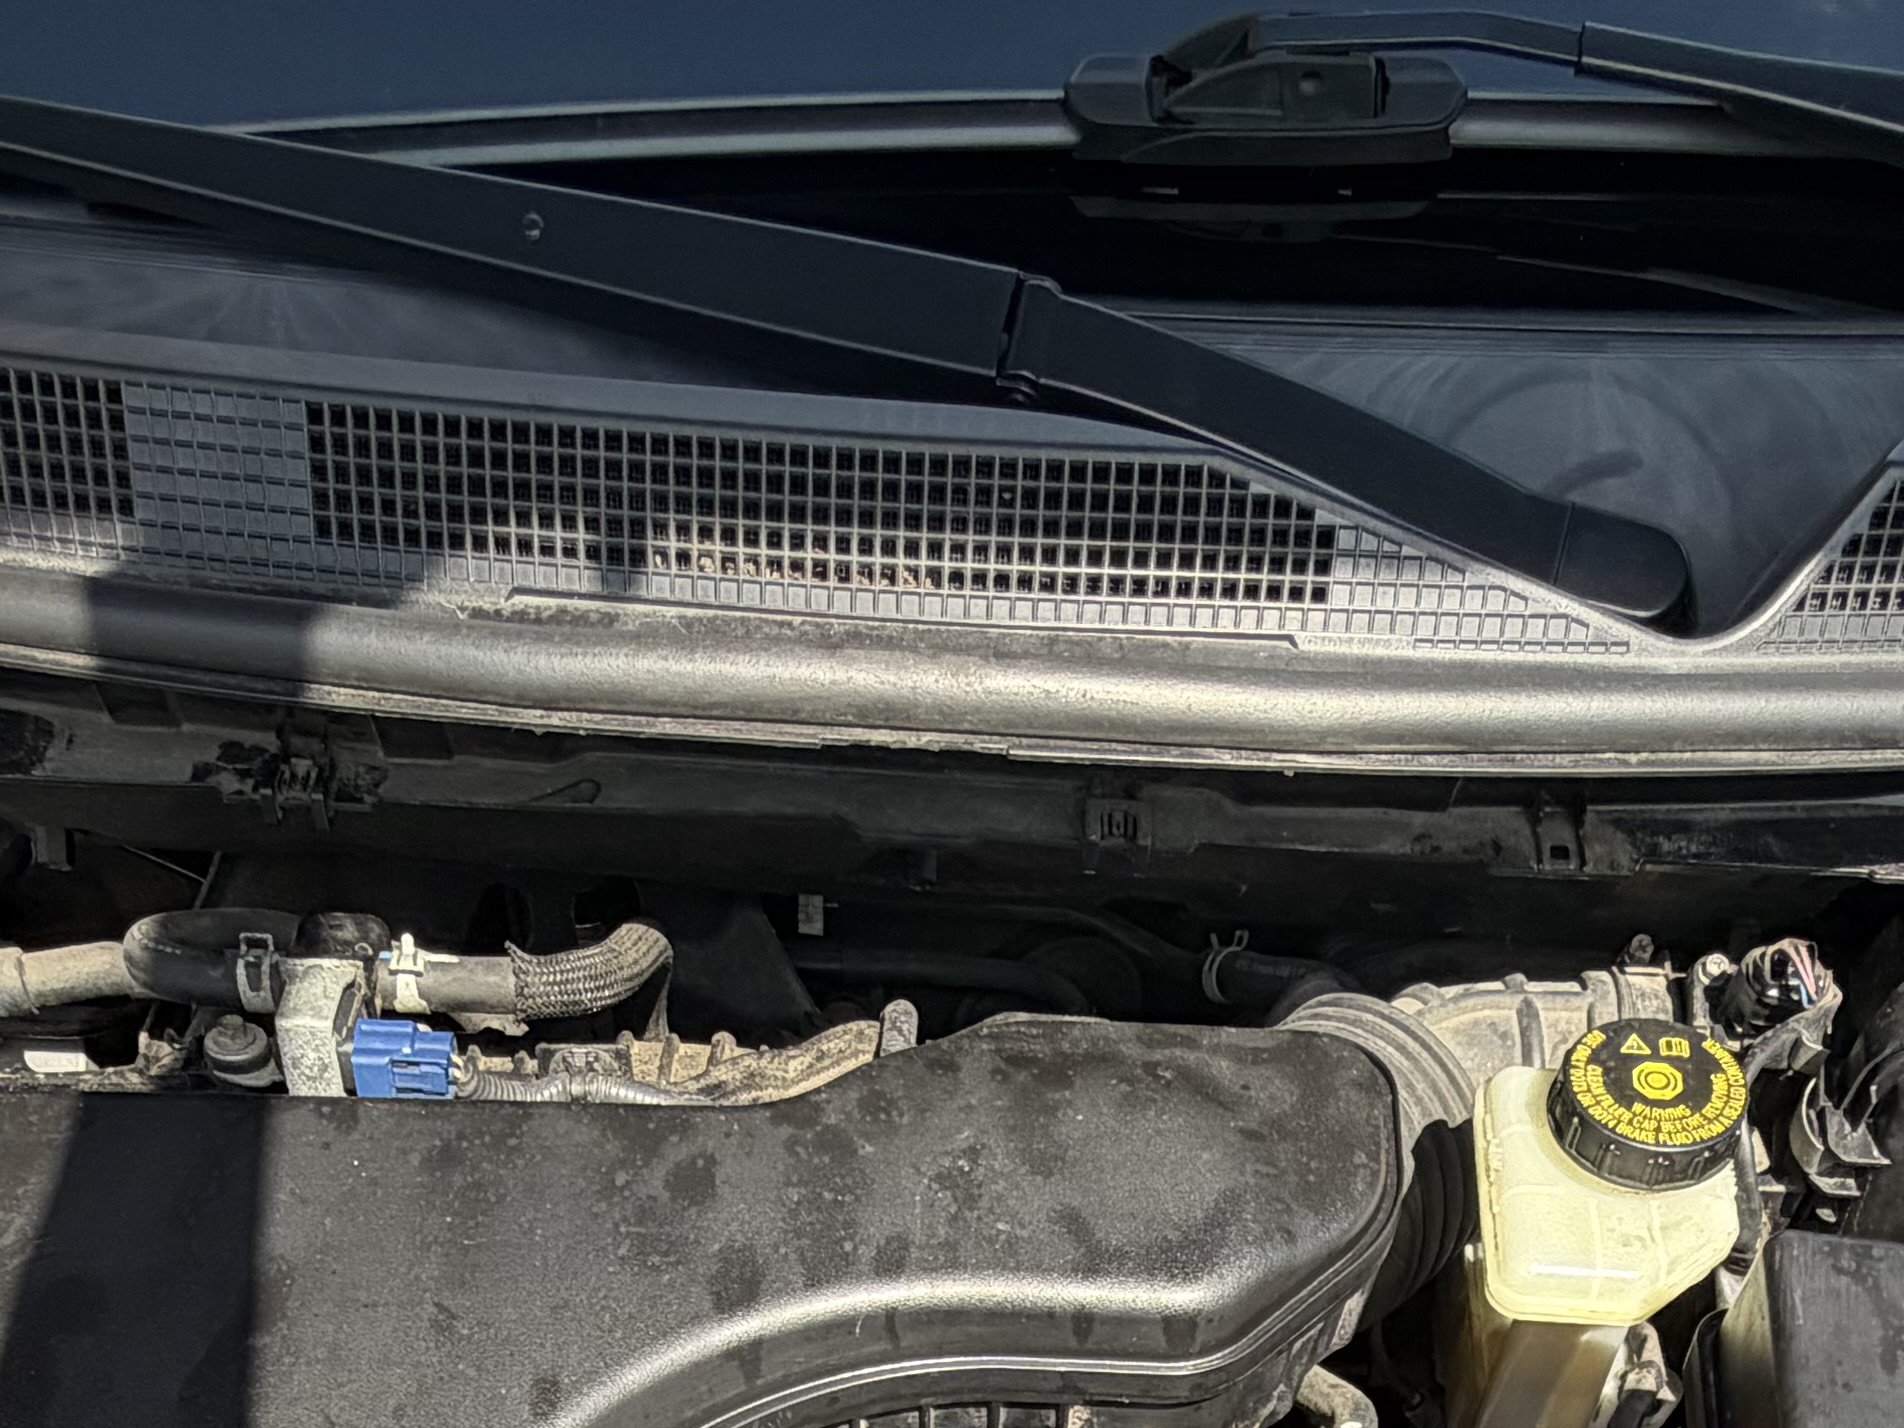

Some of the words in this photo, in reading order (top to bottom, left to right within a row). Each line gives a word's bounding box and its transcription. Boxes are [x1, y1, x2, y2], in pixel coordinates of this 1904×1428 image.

[1582, 1030, 1606, 1049] USE
[1571, 1044, 1591, 1068] ONLY
[1702, 1039, 1745, 1085] CONTAINER
[1577, 1091, 1594, 1107] OR
[1587, 1065, 1607, 1101] CLEAN
[1598, 1094, 1633, 1121] FILLER
[1633, 1115, 1658, 1131] CAP
[1661, 1113, 1707, 1133] BEFORE
[1702, 1073, 1729, 1118] REMOVING
[1722, 1087, 1746, 1121] SEALED
[1588, 1104, 1617, 1128] DOT4
[1632, 1102, 1691, 1120] WARNING
[1722, 1115, 1734, 1127] A
[1616, 1123, 1656, 1144] BRAKE
[1659, 1132, 1693, 1146] FLUID
[1692, 1123, 1725, 1142] FROM
